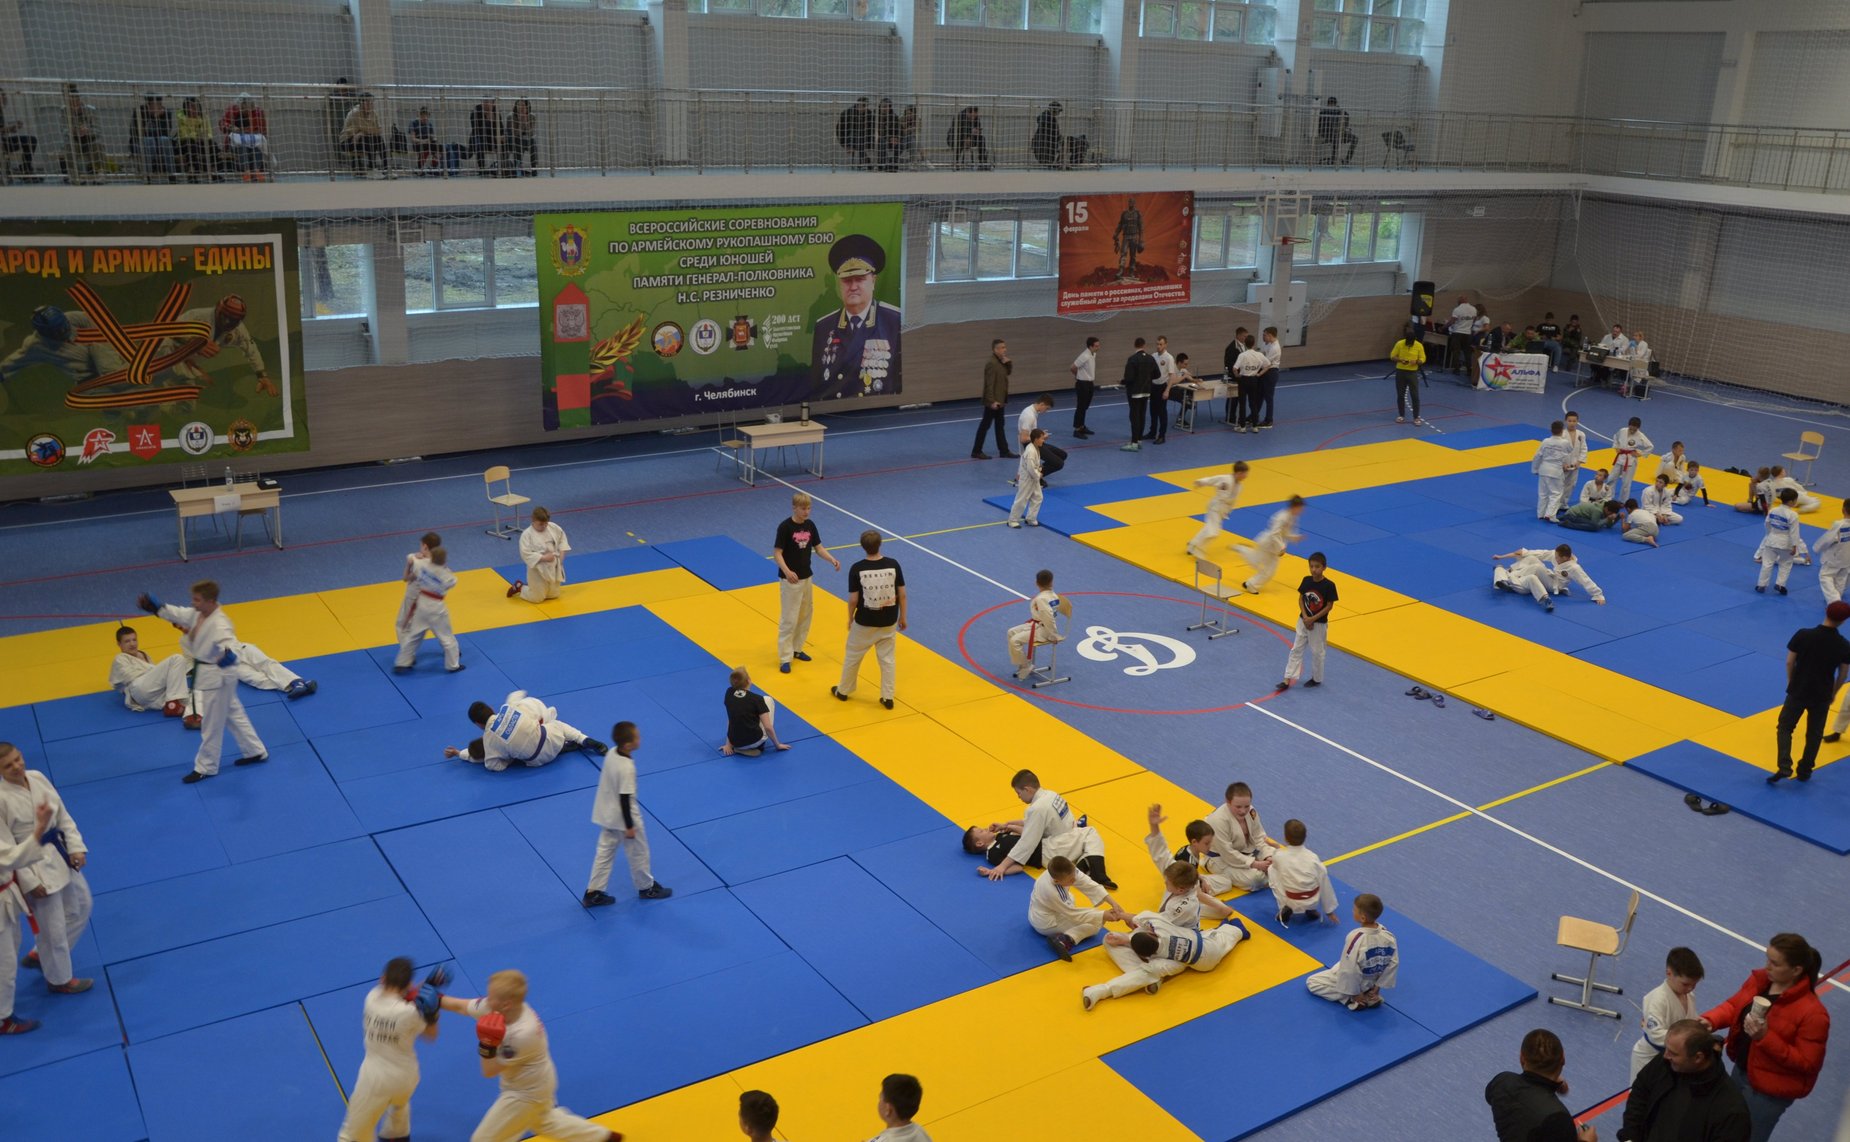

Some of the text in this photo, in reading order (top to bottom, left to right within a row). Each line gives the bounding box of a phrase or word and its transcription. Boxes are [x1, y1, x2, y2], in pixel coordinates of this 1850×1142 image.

[1065, 201, 1089, 224] 15
[629, 217, 817, 234] ВСЕРОССИЙСКИЕ СОРЕВНОВАНИЯ
[609, 233, 834, 253] ПО АРМЕЙСКОМУ РУКОПАШНОМУ БОЮ
[67, 248, 84, 273] И
[93, 247, 173, 273] АРМИЯ
[194, 246, 271, 275] ЕДИНЫ
[679, 250, 774, 268] СРЕДИ ЮНОШЕЙ
[633, 267, 814, 288] ПАМЯТИ ГЕНЕРАЛ-ПОЛКОВНИКА
[677, 287, 775, 303] Н.С. РЕЗНИЧЕНКО
[771, 314, 786, 325] 200
[694, 388, 757, 402] г. Челябинск
